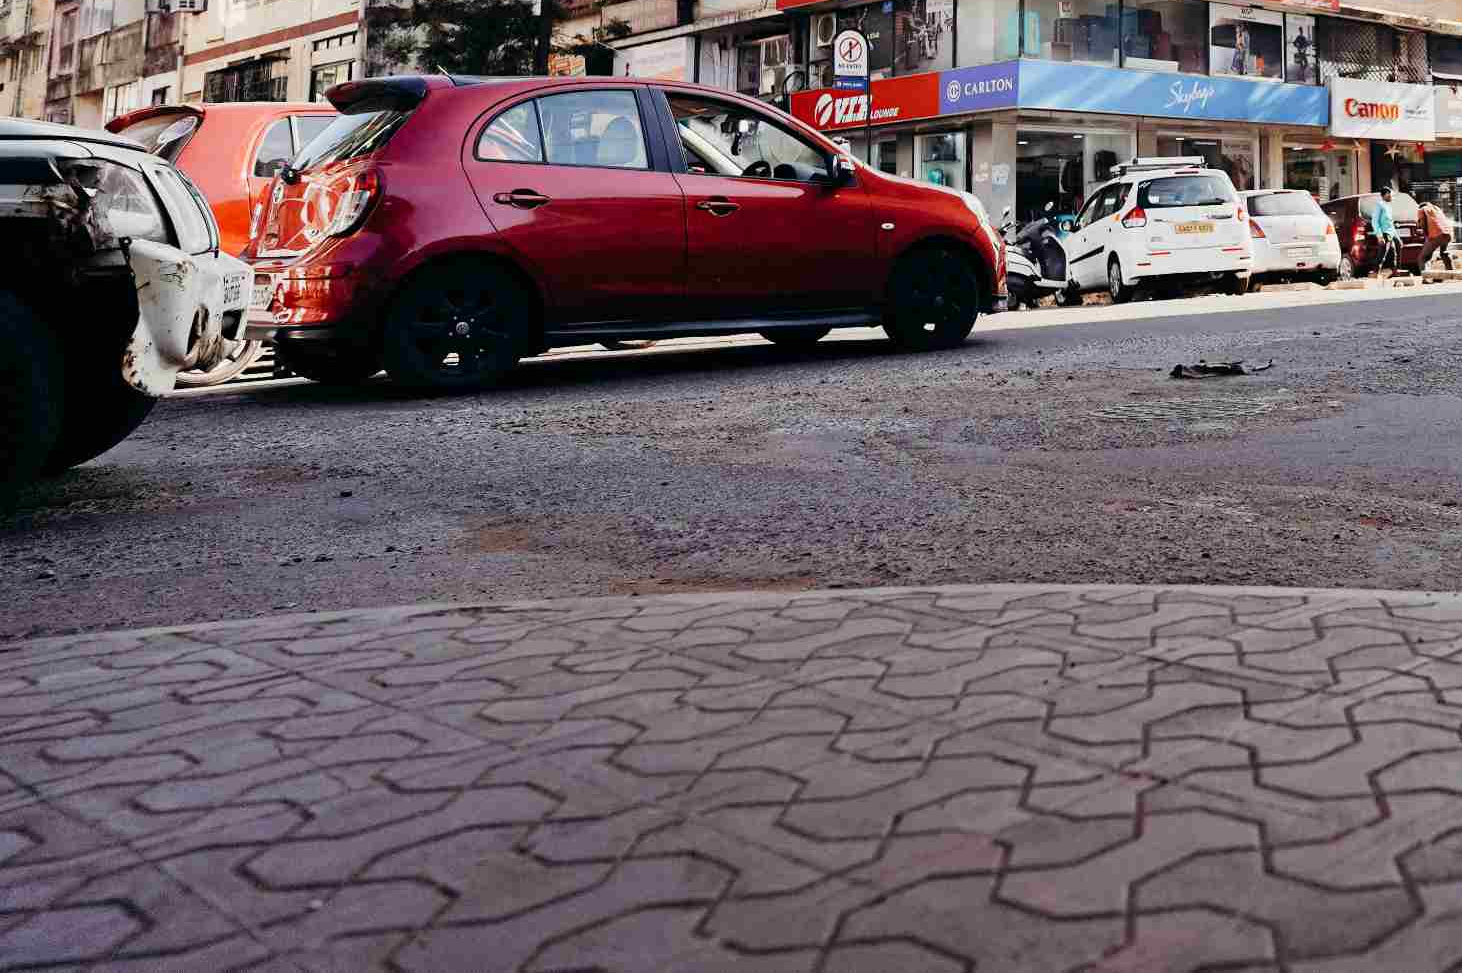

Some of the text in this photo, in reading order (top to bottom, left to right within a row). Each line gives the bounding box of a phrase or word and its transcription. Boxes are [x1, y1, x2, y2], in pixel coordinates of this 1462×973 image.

[964, 78, 1013, 96] CARLTON
[870, 106, 900, 119] LOUNGE
[1343, 97, 1401, 122] Canon
